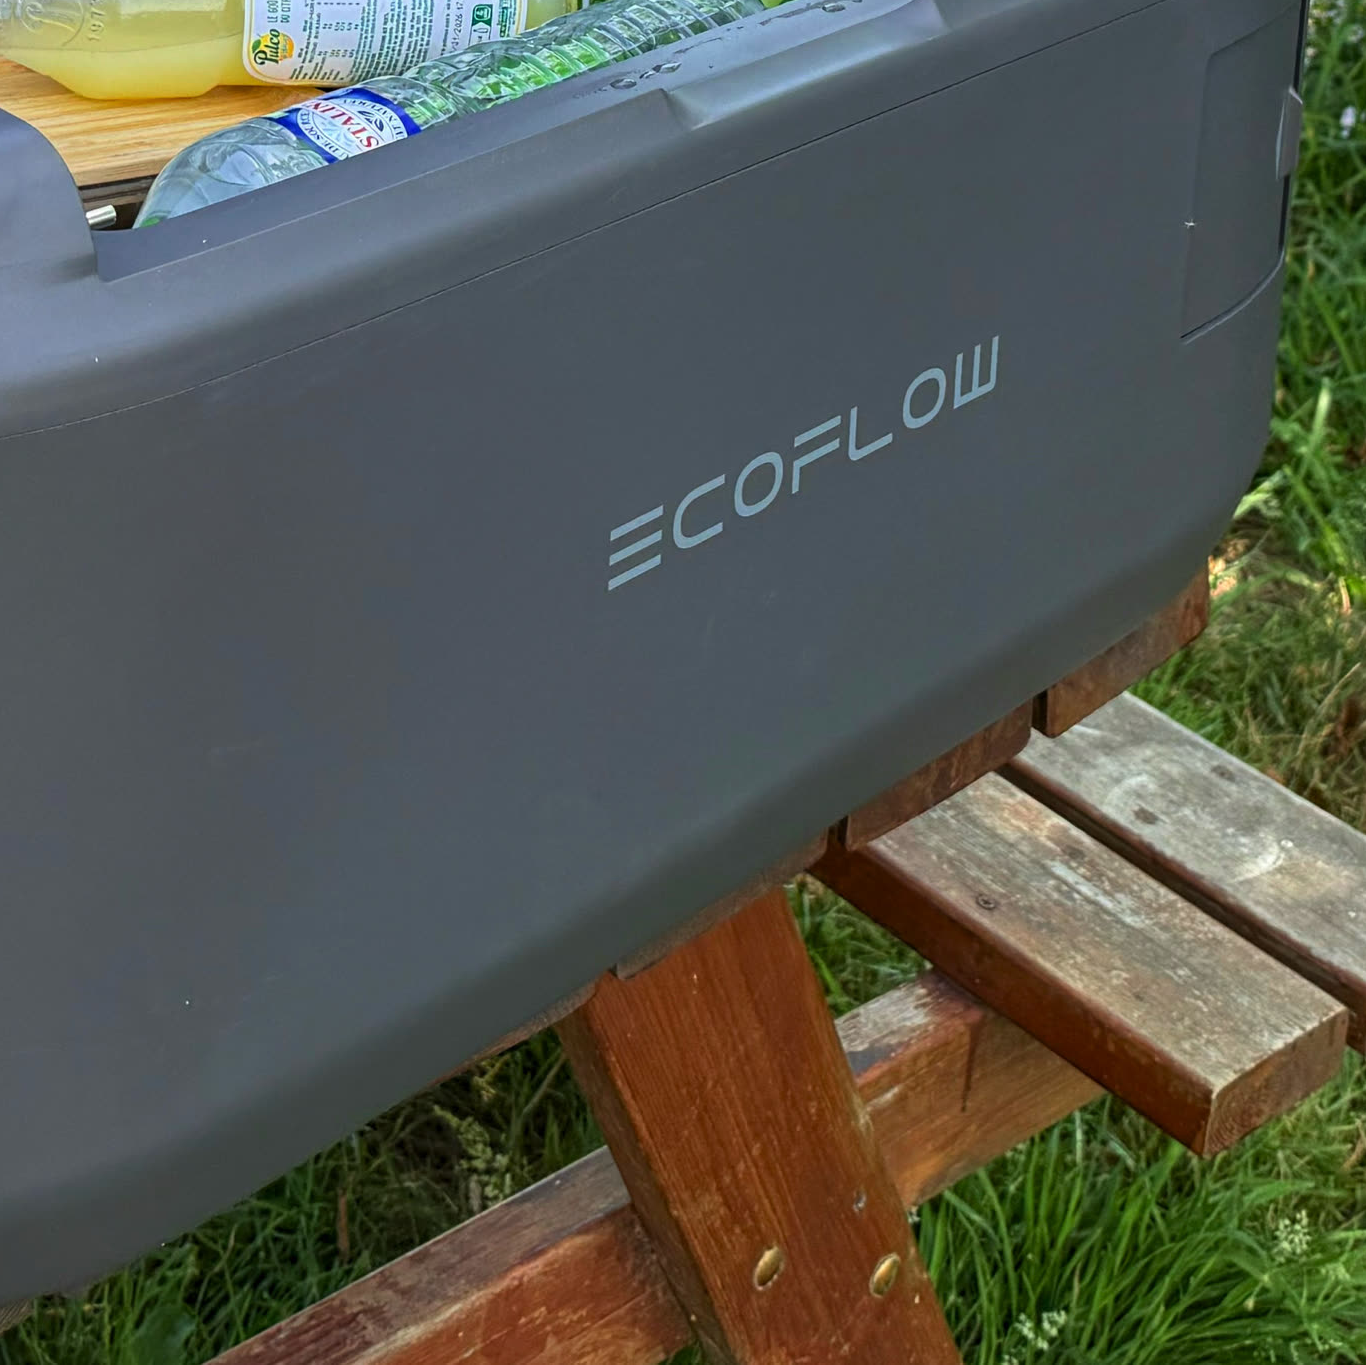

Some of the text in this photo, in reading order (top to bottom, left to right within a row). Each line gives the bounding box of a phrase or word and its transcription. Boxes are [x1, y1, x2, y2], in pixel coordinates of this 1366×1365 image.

[253, 29, 280, 65] Pulco
[302, 101, 379, 148] STALIN
[608, 335, 1000, 592] ECOFLOW
